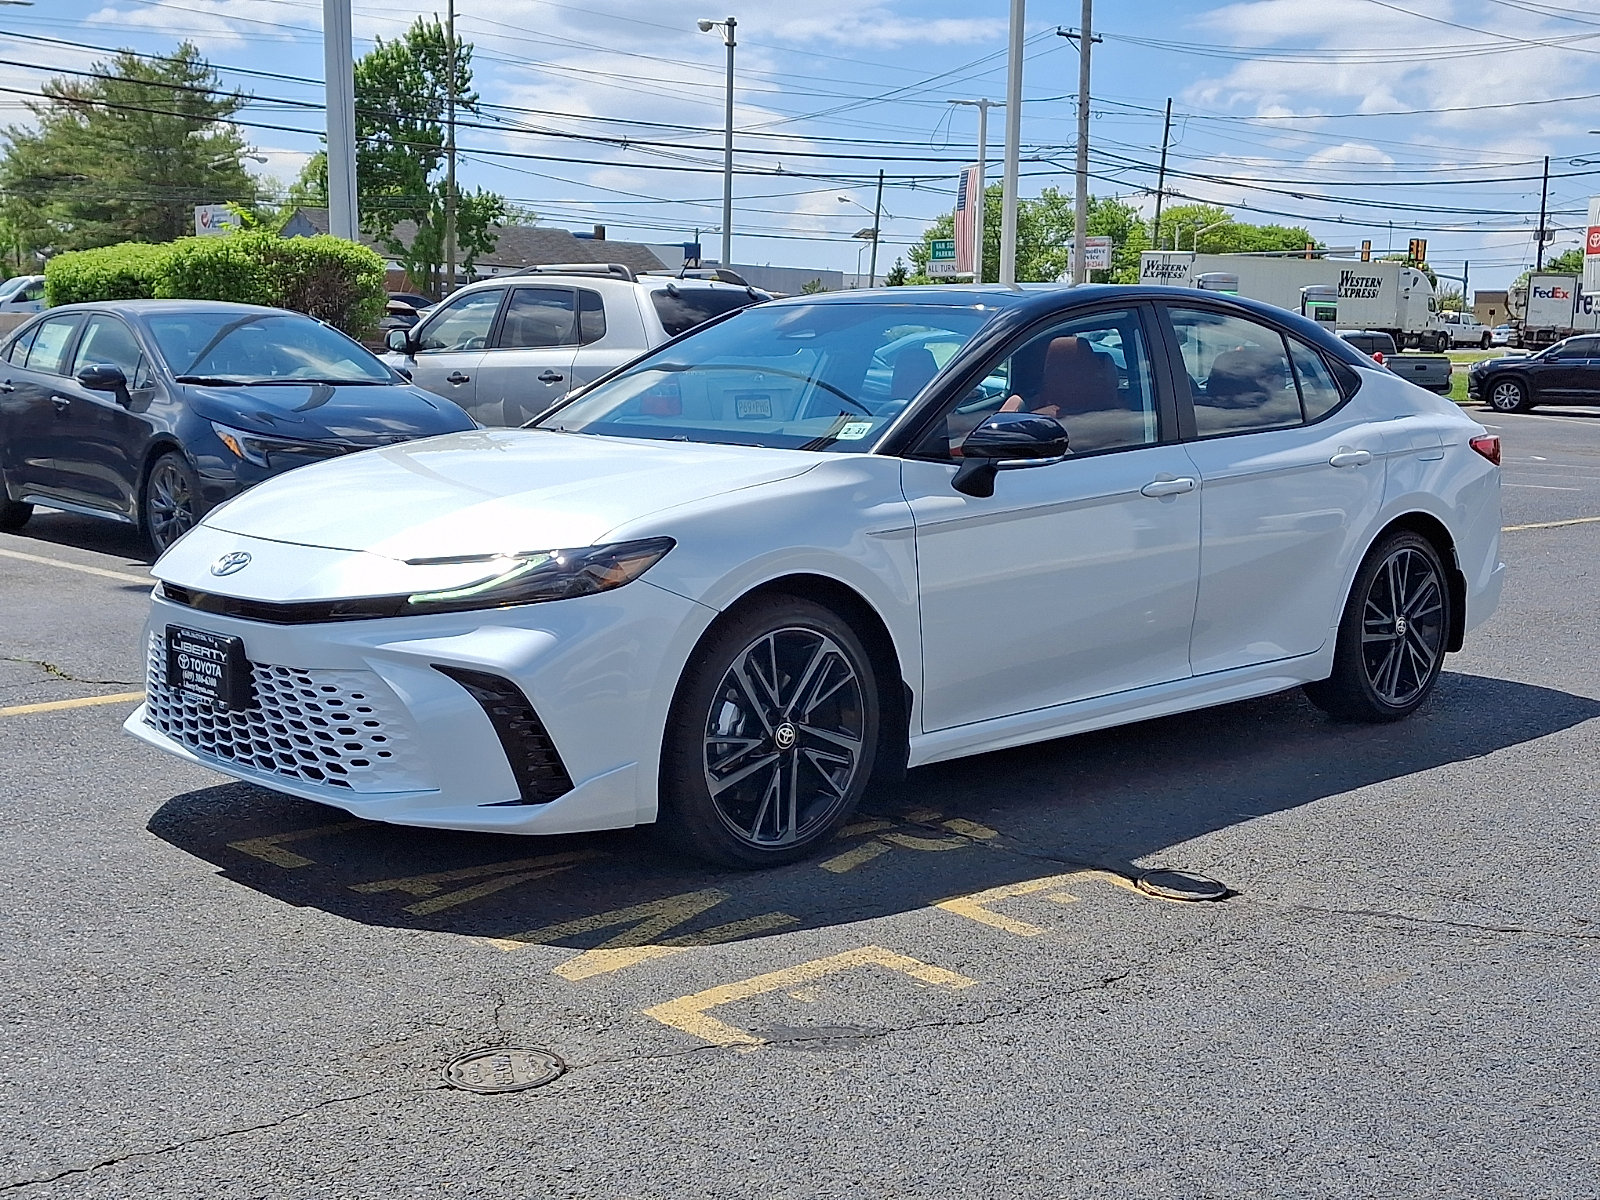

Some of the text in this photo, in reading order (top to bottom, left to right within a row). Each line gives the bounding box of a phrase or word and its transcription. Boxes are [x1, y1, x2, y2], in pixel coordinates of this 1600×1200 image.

[940, 264, 956, 272] TURN
[1146, 260, 1189, 271] WESTERN
[1341, 270, 1383, 288] WESTERN
[1533, 287, 1569, 299] FedEx
[1575, 283, 1593, 315] Fe
[171, 639, 227, 662] LIBERTY
[190, 658, 222, 678] TOYOTA
